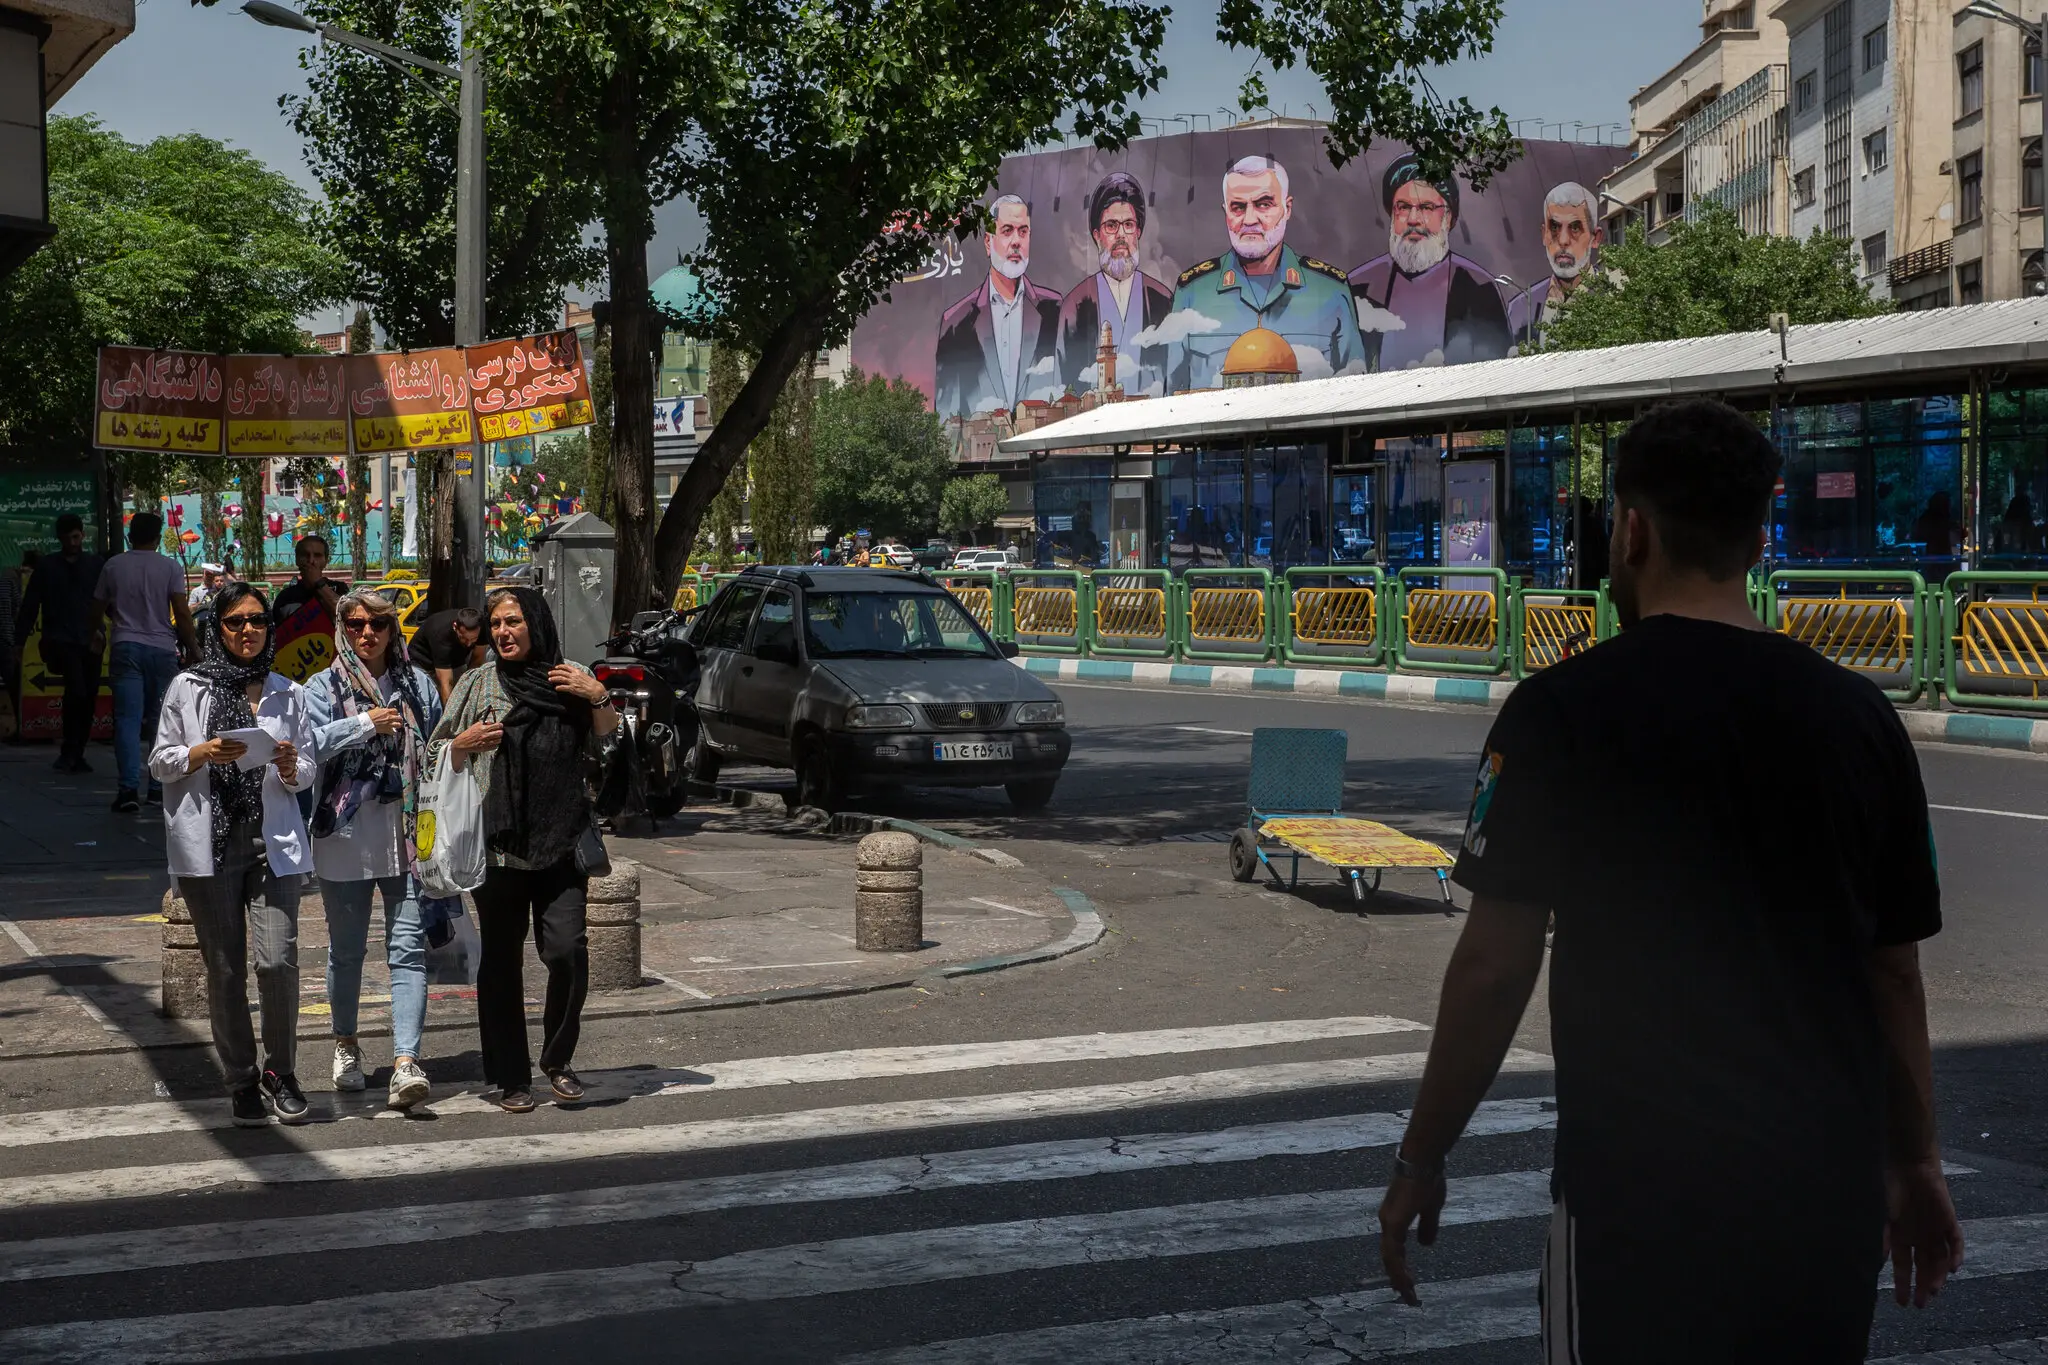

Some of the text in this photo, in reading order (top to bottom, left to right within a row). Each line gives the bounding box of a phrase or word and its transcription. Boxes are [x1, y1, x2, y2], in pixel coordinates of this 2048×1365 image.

[101, 352, 223, 409] دانشگاهی
[468, 345, 527, 390] درسی
[227, 364, 345, 415] ارشد و دکتری
[351, 358, 468, 415] روانشناسی
[474, 367, 580, 413] کنکوری
[112, 415, 210, 448] کلیه رشته ها
[230, 427, 277, 446] استخدامی
[284, 429, 320, 445] مهندسی
[323, 426, 344, 445] نظام
[359, 420, 394, 447] رمان
[409, 413, 468, 444] انگیزشی
[18, 483, 30, 495] در
[32, 480, 63, 494] تخفیف
[83, 480, 93, 492] تا
[0, 496, 91, 513] جشنواره کتاب صوتی
[292, 638, 330, 681] پایان
